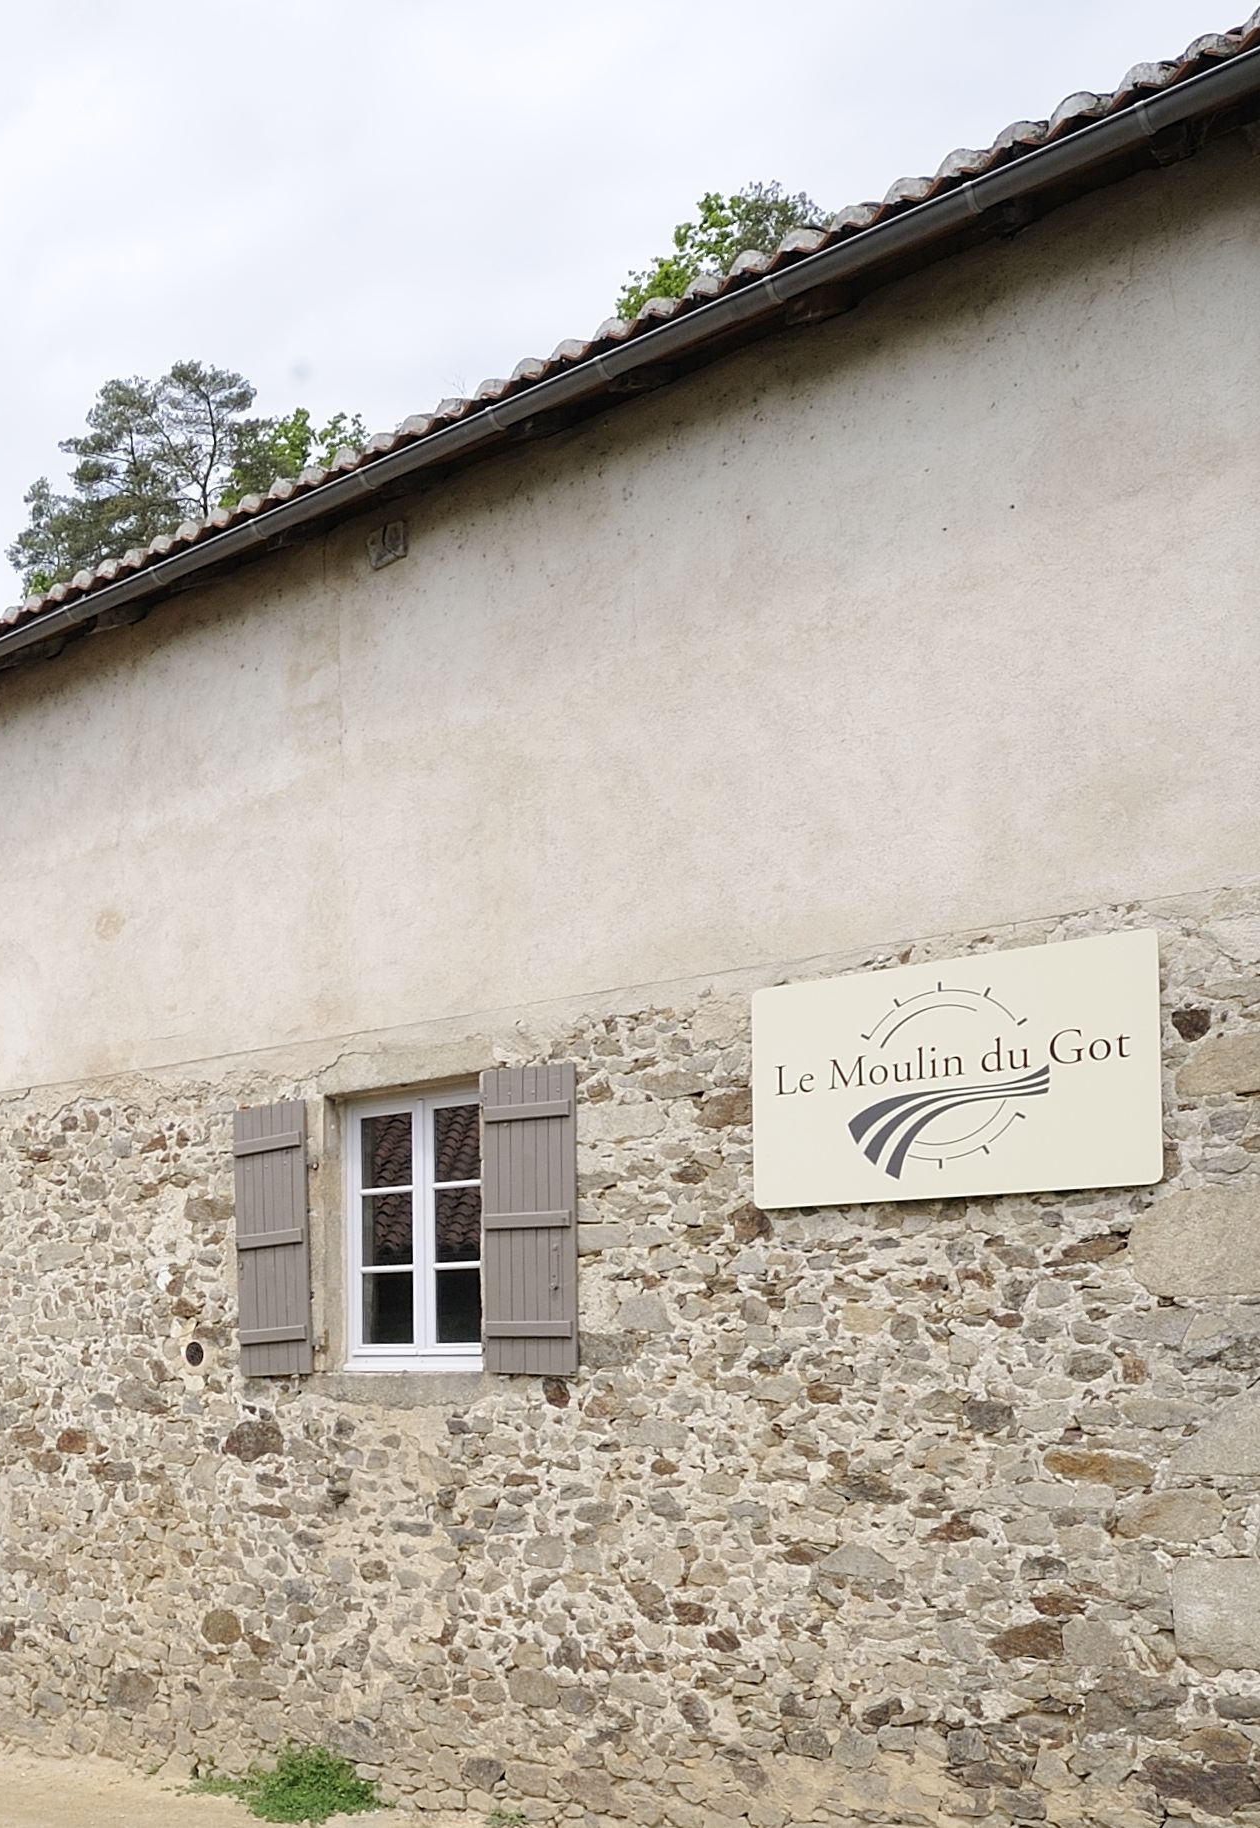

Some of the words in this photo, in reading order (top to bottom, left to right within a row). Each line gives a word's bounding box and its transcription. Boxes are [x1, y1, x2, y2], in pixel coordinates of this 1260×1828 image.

[776, 1066, 814, 1095] Le
[829, 1047, 964, 1089] Moulin
[982, 1037, 1030, 1072] du
[1050, 1029, 1130, 1064] Got
